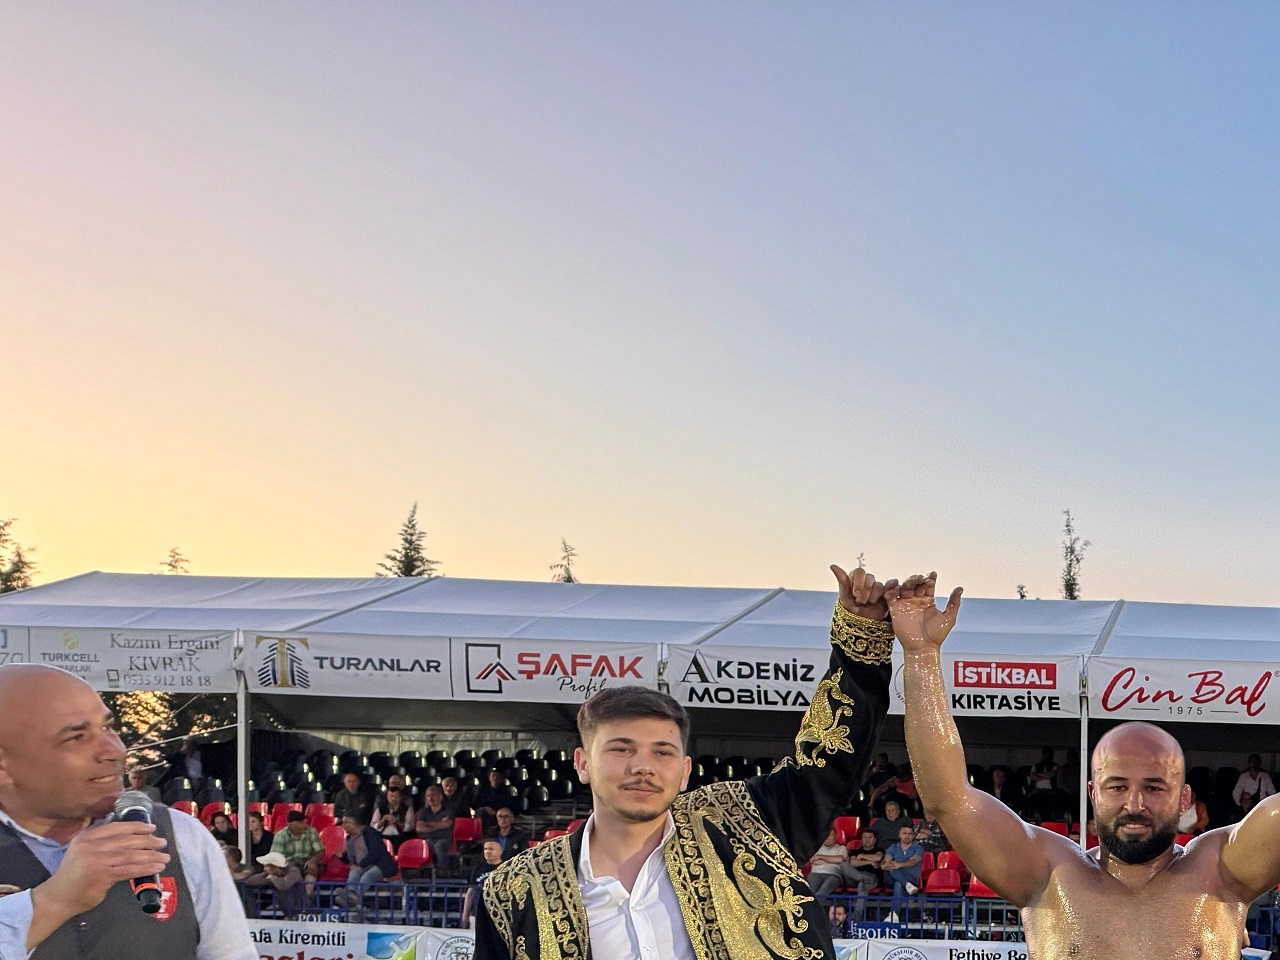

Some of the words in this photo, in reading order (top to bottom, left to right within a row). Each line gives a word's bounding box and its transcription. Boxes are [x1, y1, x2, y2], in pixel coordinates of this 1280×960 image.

[110, 633, 161, 649] Kazım
[167, 634, 220, 656] Ergani
[128, 655, 201, 672] KIVRAK
[313, 656, 442, 673] TURANLAR
[517, 652, 644, 680] ŞAFAK
[679, 648, 816, 684] AKDENİZ
[957, 661, 1054, 685] İSTİKBAL
[154, 674, 175, 686] 912
[181, 675, 193, 686] 18
[198, 675, 211, 687] 18
[688, 685, 812, 706] MOBİLYA
[952, 691, 1061, 710] KIRTASİYE
[1101, 667, 1184, 712] Cin
[1187, 670, 1273, 717] Bal
[1167, 706, 1204, 715] 1975
[279, 929, 346, 946] Kiremitli
